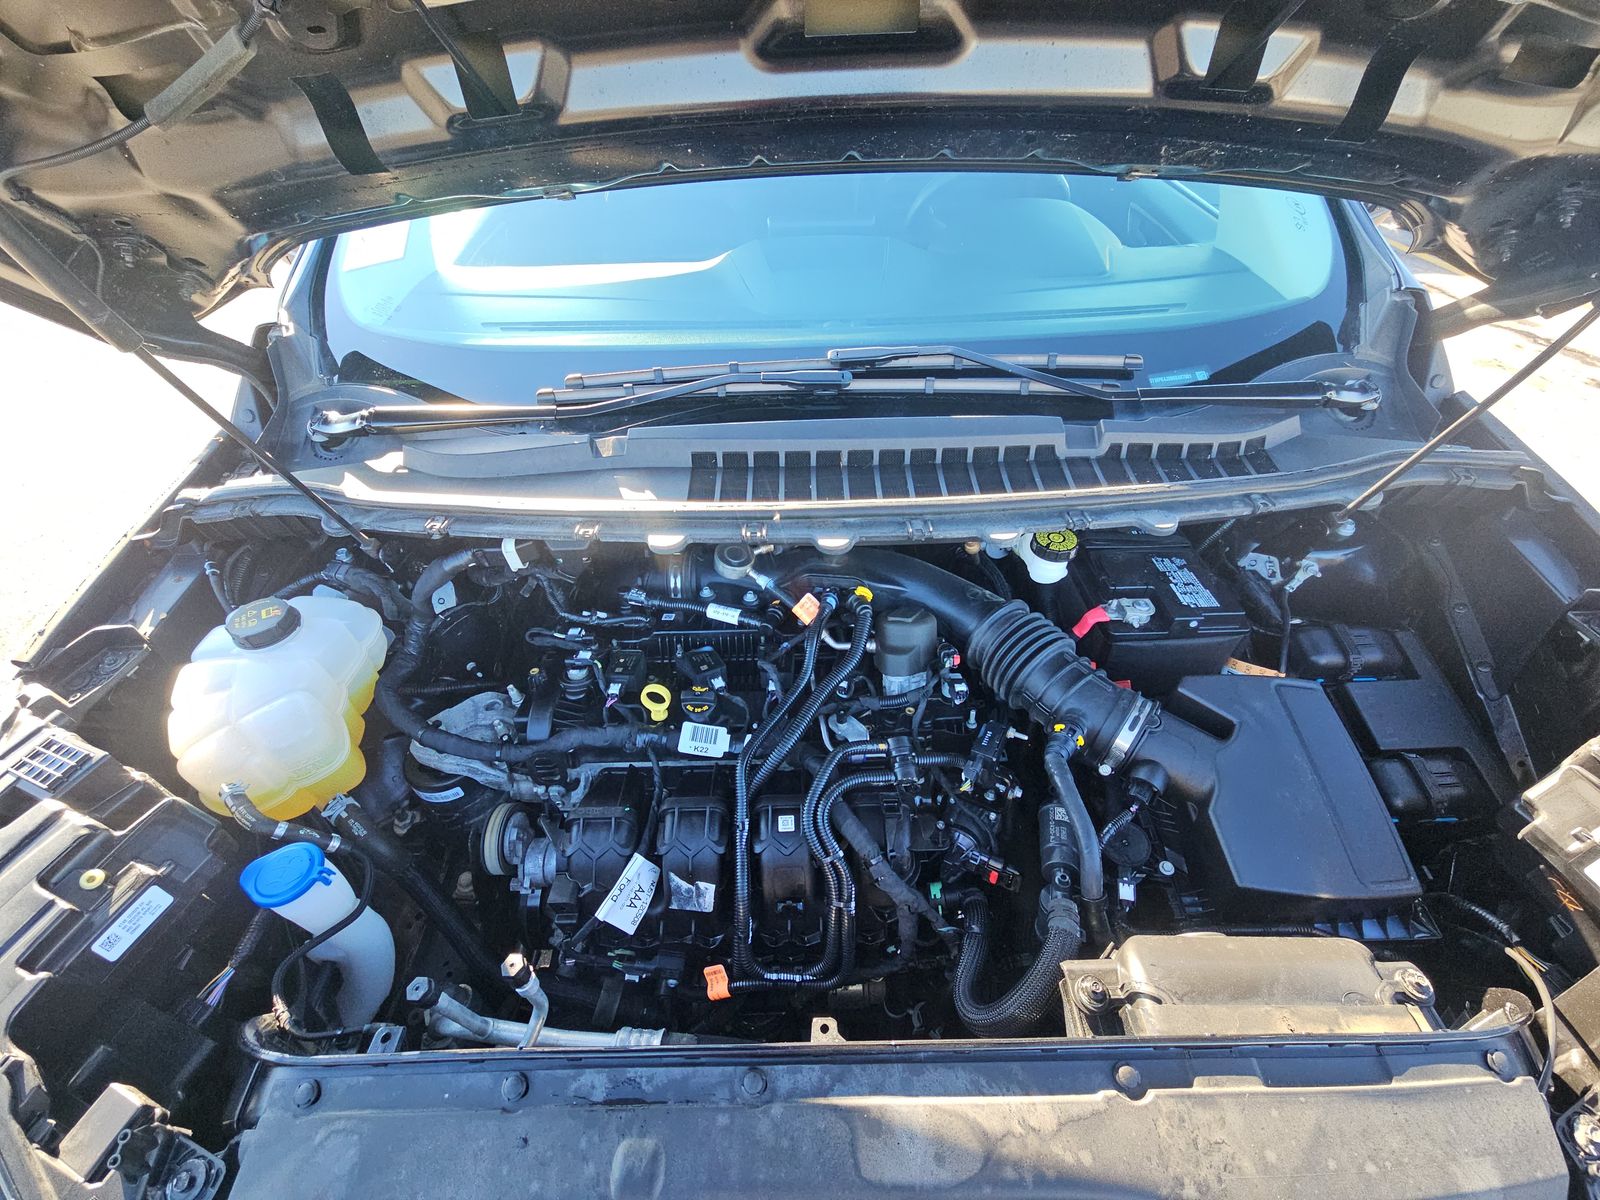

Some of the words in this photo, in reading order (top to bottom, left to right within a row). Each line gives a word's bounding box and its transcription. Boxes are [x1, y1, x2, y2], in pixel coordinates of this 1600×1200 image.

[693, 745, 709, 754] K22
[611, 877, 631, 902] Ford
[626, 884, 645, 909] AAA
